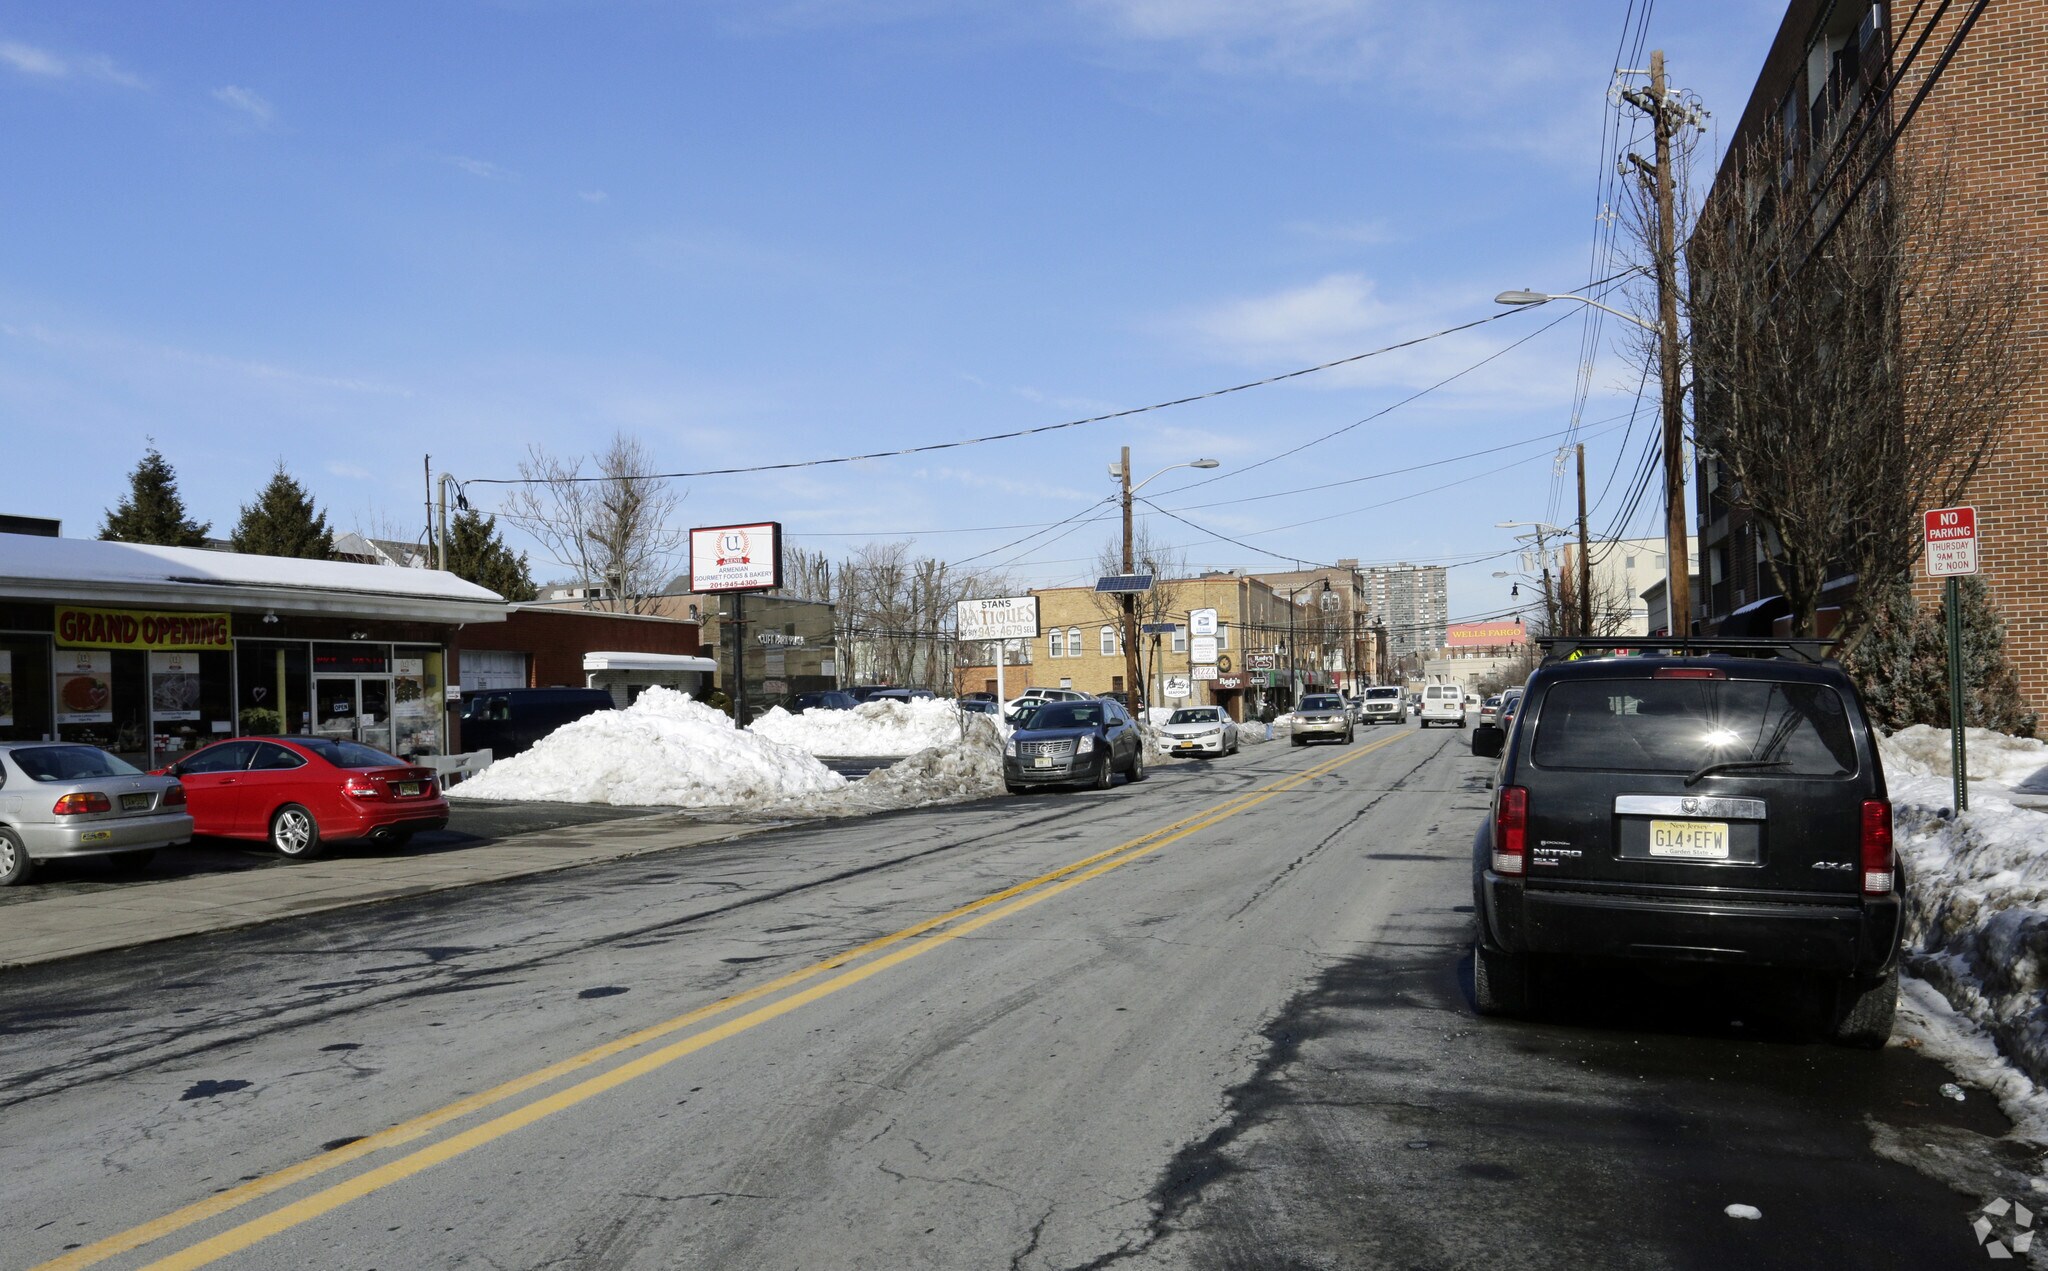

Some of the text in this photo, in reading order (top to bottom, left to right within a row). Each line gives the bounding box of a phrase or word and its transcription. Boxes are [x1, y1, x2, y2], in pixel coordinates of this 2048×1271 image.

[1940, 512, 1958, 526] NO
[1930, 526, 1970, 539] PARKING
[1932, 541, 1969, 551] THURSDAY
[1936, 551, 1966, 560] 9AM TO
[719, 566, 748, 574] ARMENIAN
[1935, 561, 1969, 571] 12 NOON
[694, 574, 722, 582] GOURMET
[709, 579, 757, 588] 201-945-4300
[981, 599, 1011, 609] STANS
[59, 611, 228, 645] GRAND OPENING
[1023, 626, 1035, 634] SELL
[1452, 628, 1521, 638] WELLS FARGO
[1193, 667, 1216, 675] PIZZA
[334, 703, 348, 712] OPEN
[1655, 829, 1723, 849] G14 EFW
[1533, 848, 1582, 858] NITRO
